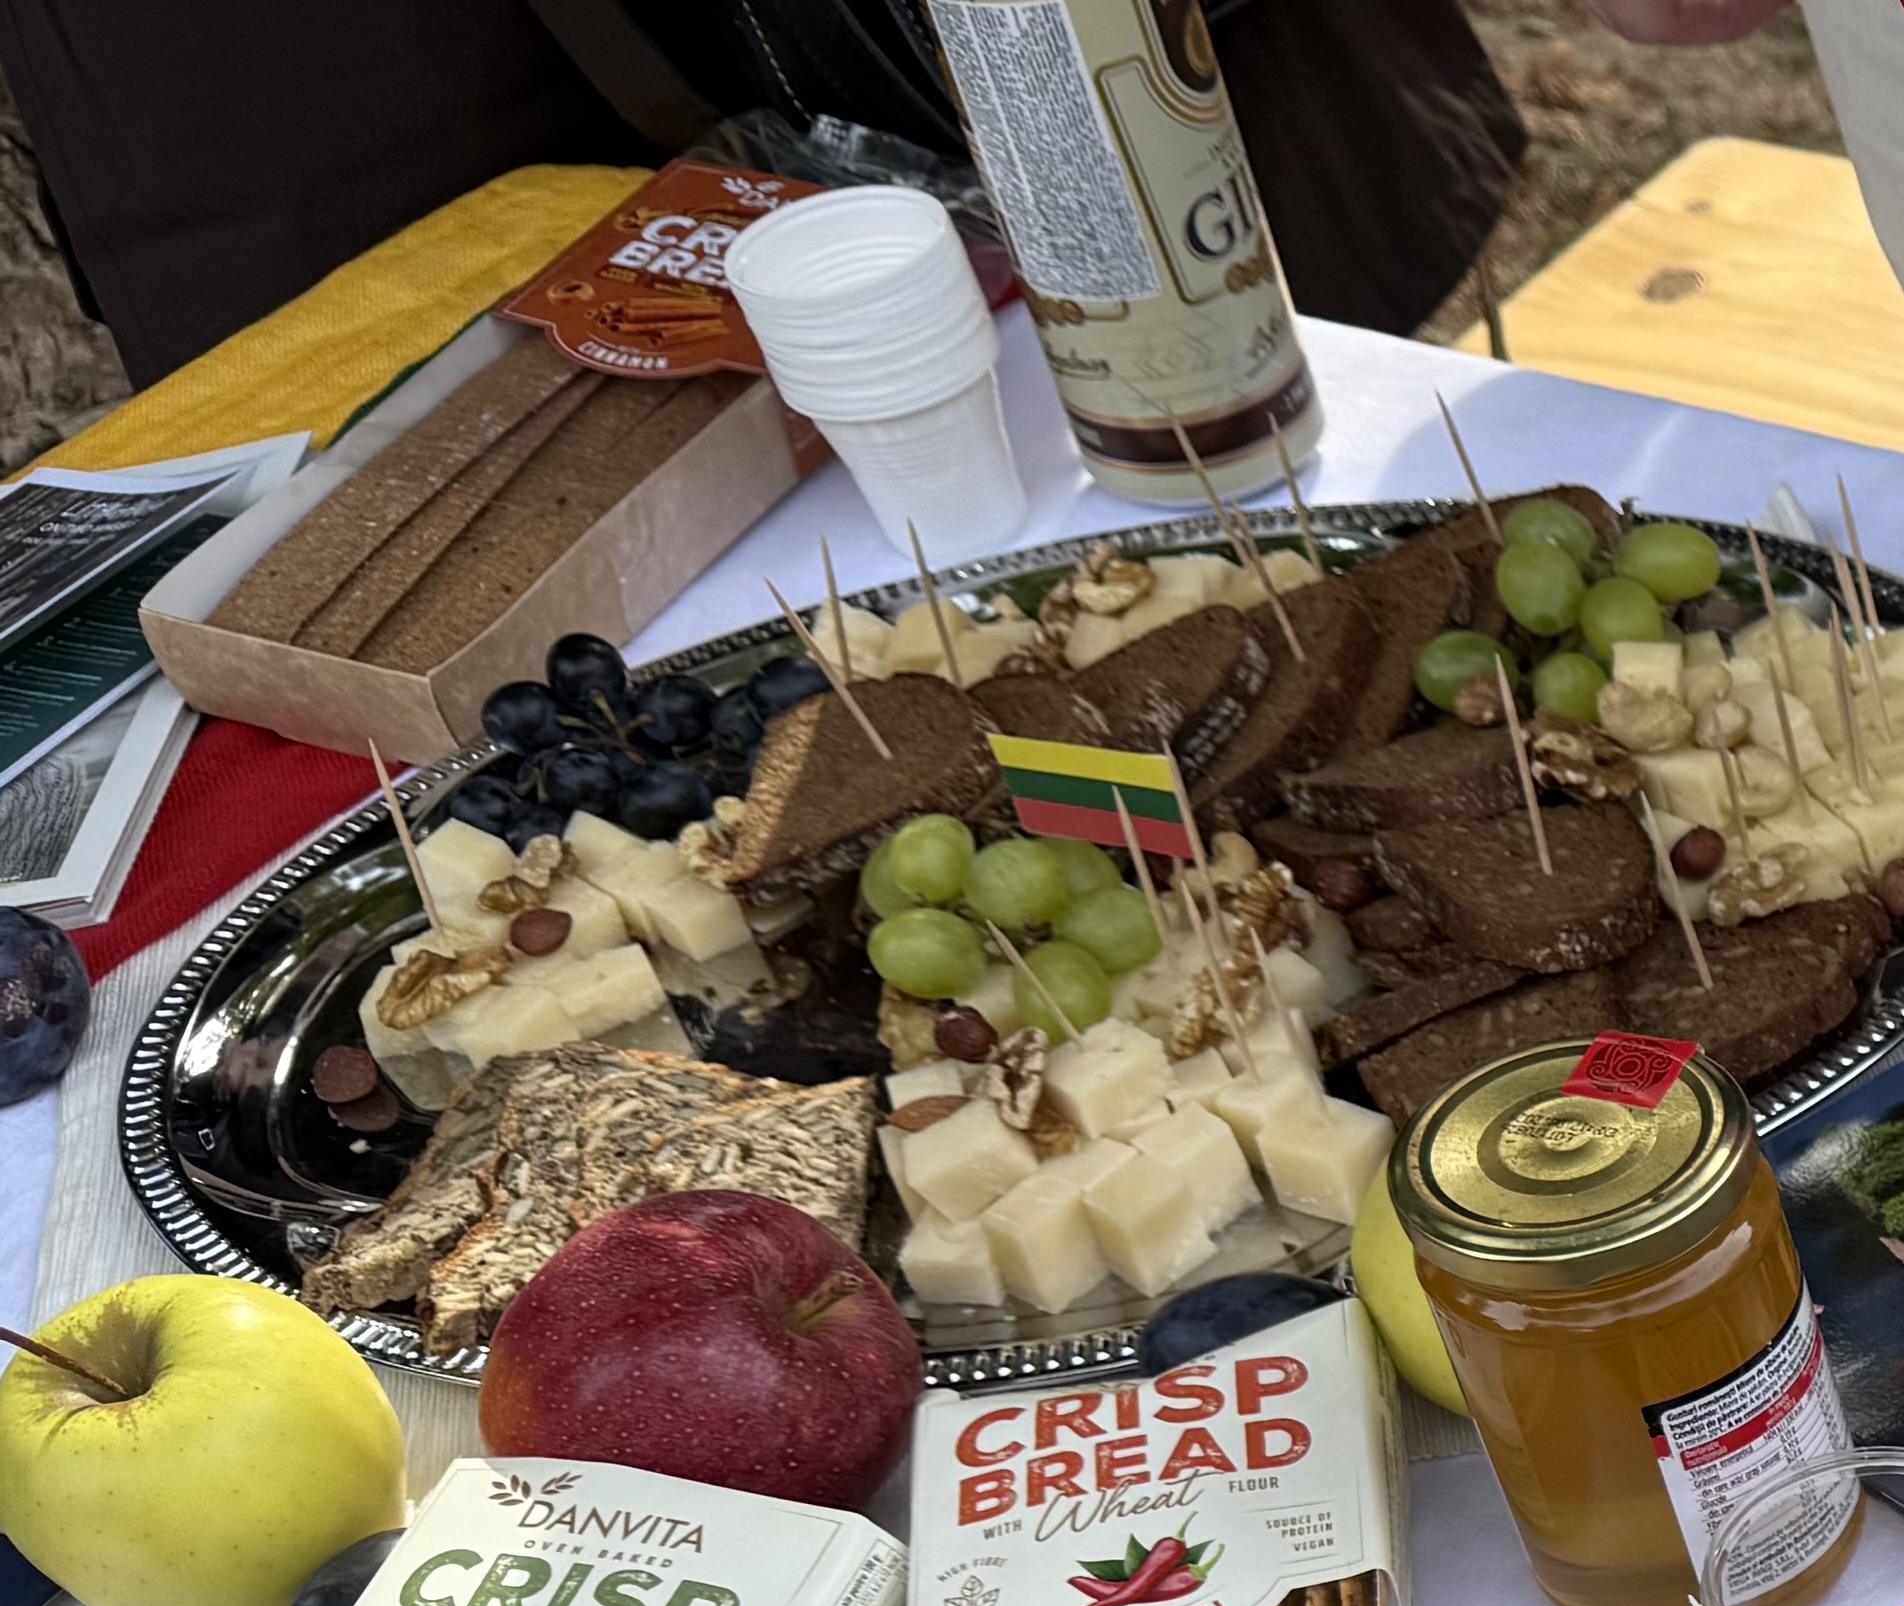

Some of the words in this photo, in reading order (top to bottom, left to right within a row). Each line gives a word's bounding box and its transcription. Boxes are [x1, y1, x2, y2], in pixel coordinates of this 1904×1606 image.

[955, 1355, 1309, 1468] CRISP
[957, 1418, 1312, 1527] BREAD
[518, 1500, 705, 1554] DANVITA
[983, 1519, 1024, 1540] WITH
[1035, 1469, 1227, 1543] Wheat
[1229, 1476, 1279, 1494] FLOUR
[1265, 1515, 1313, 1532] SOURCE
[1317, 1512, 1333, 1524] OF
[1281, 1521, 1334, 1538] PROTEIN
[1293, 1537, 1334, 1553] VEGAN
[523, 1539, 585, 1557] OVEN
[598, 1548, 674, 1569] BAKED
